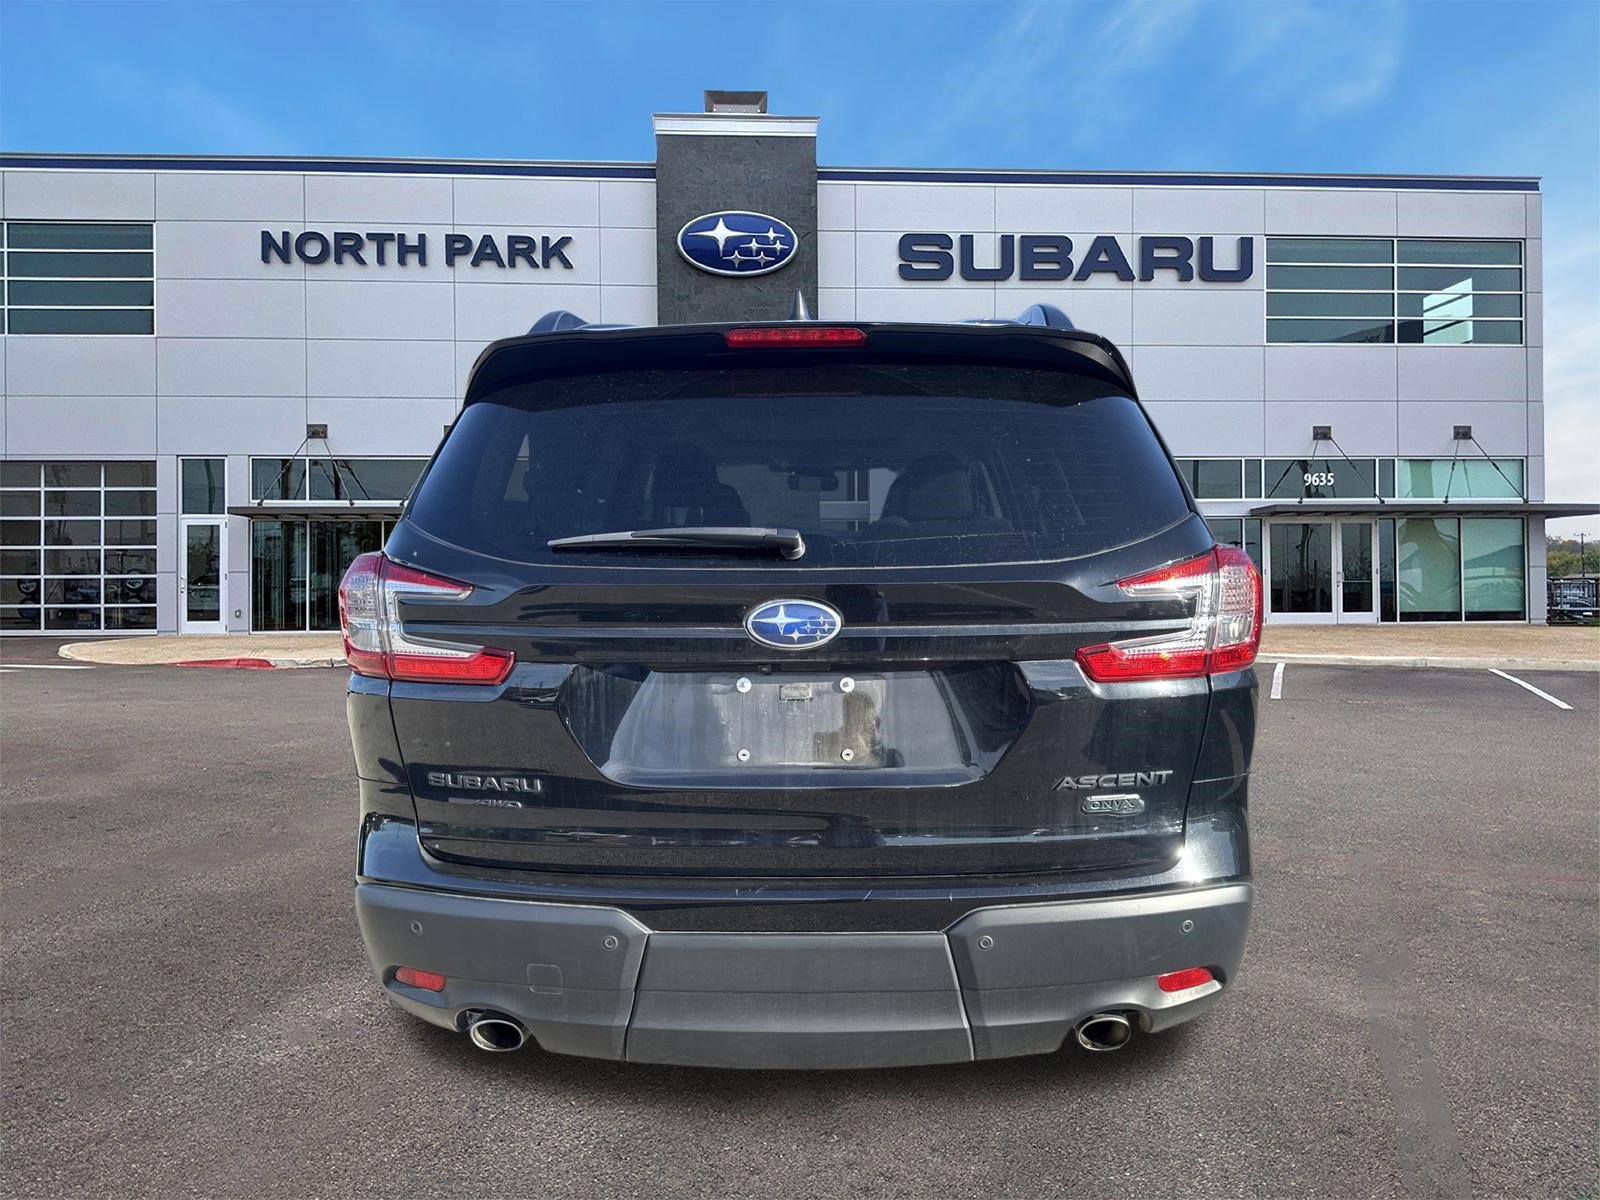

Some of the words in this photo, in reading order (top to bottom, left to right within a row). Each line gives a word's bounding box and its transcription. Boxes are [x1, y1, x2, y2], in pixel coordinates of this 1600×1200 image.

[261, 230, 427, 267] NORTH
[444, 233, 574, 269] PARK
[898, 233, 1254, 282] SUBARU
[1304, 473, 1335, 486] 9635
[427, 771, 543, 794] SUBARU
[1051, 770, 1173, 791] ASCENT
[1090, 799, 1136, 811] ONYX
